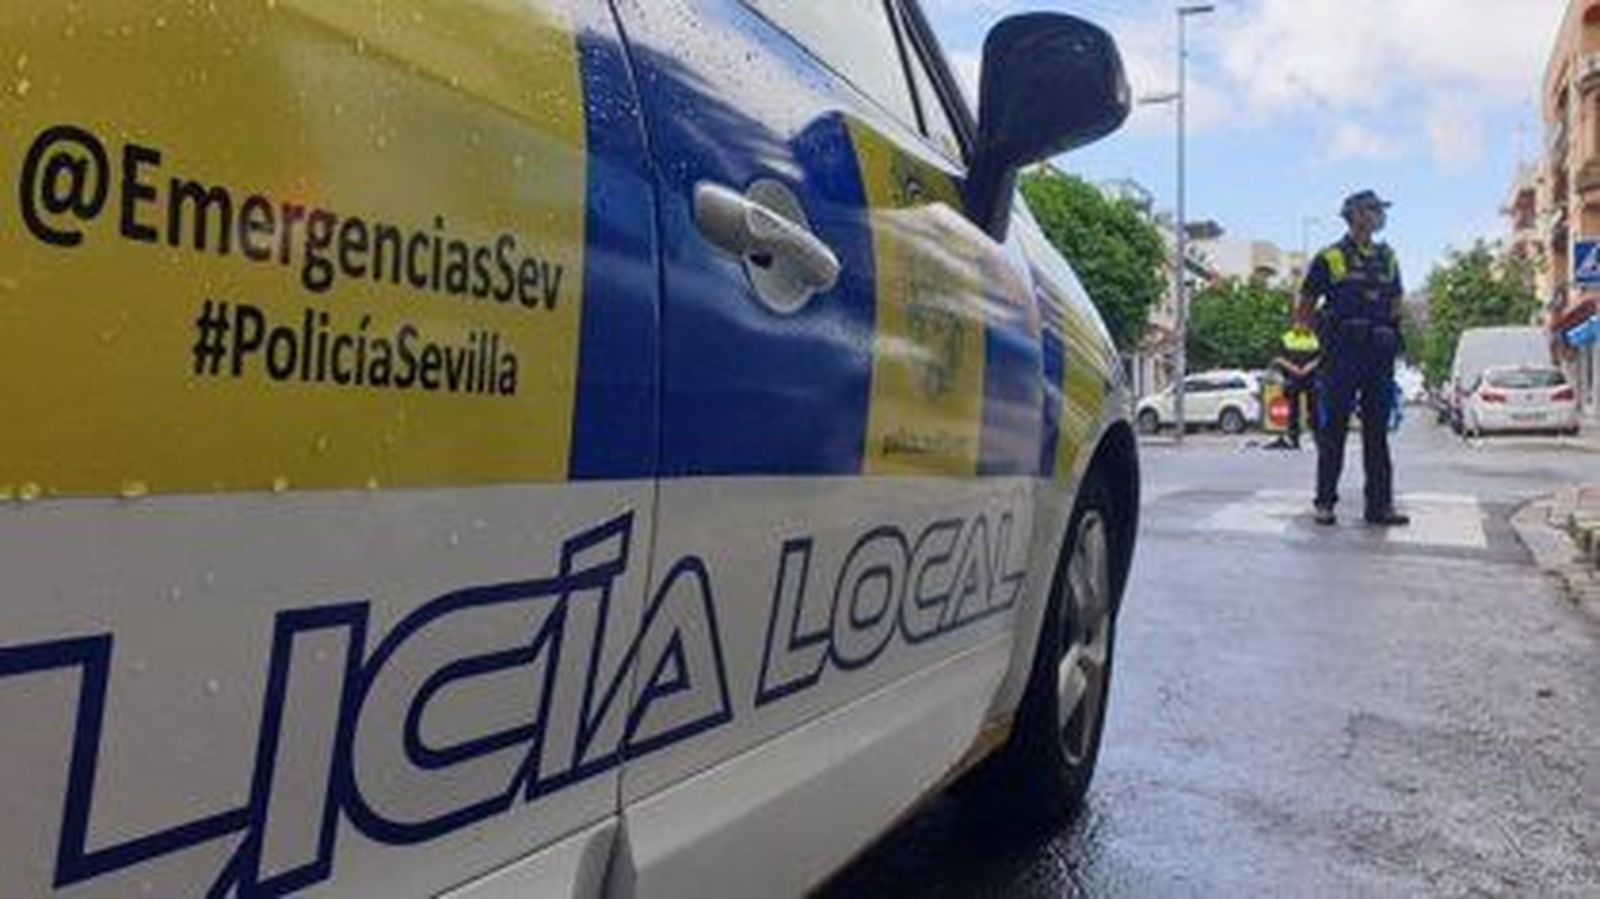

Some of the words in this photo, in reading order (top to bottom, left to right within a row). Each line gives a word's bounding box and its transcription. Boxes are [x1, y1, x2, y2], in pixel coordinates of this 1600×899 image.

[19, 125, 563, 311] @EmergenciasSev
[193, 300, 518, 395] #PolicíaSevilla
[754, 511, 1026, 708] LOCAL
